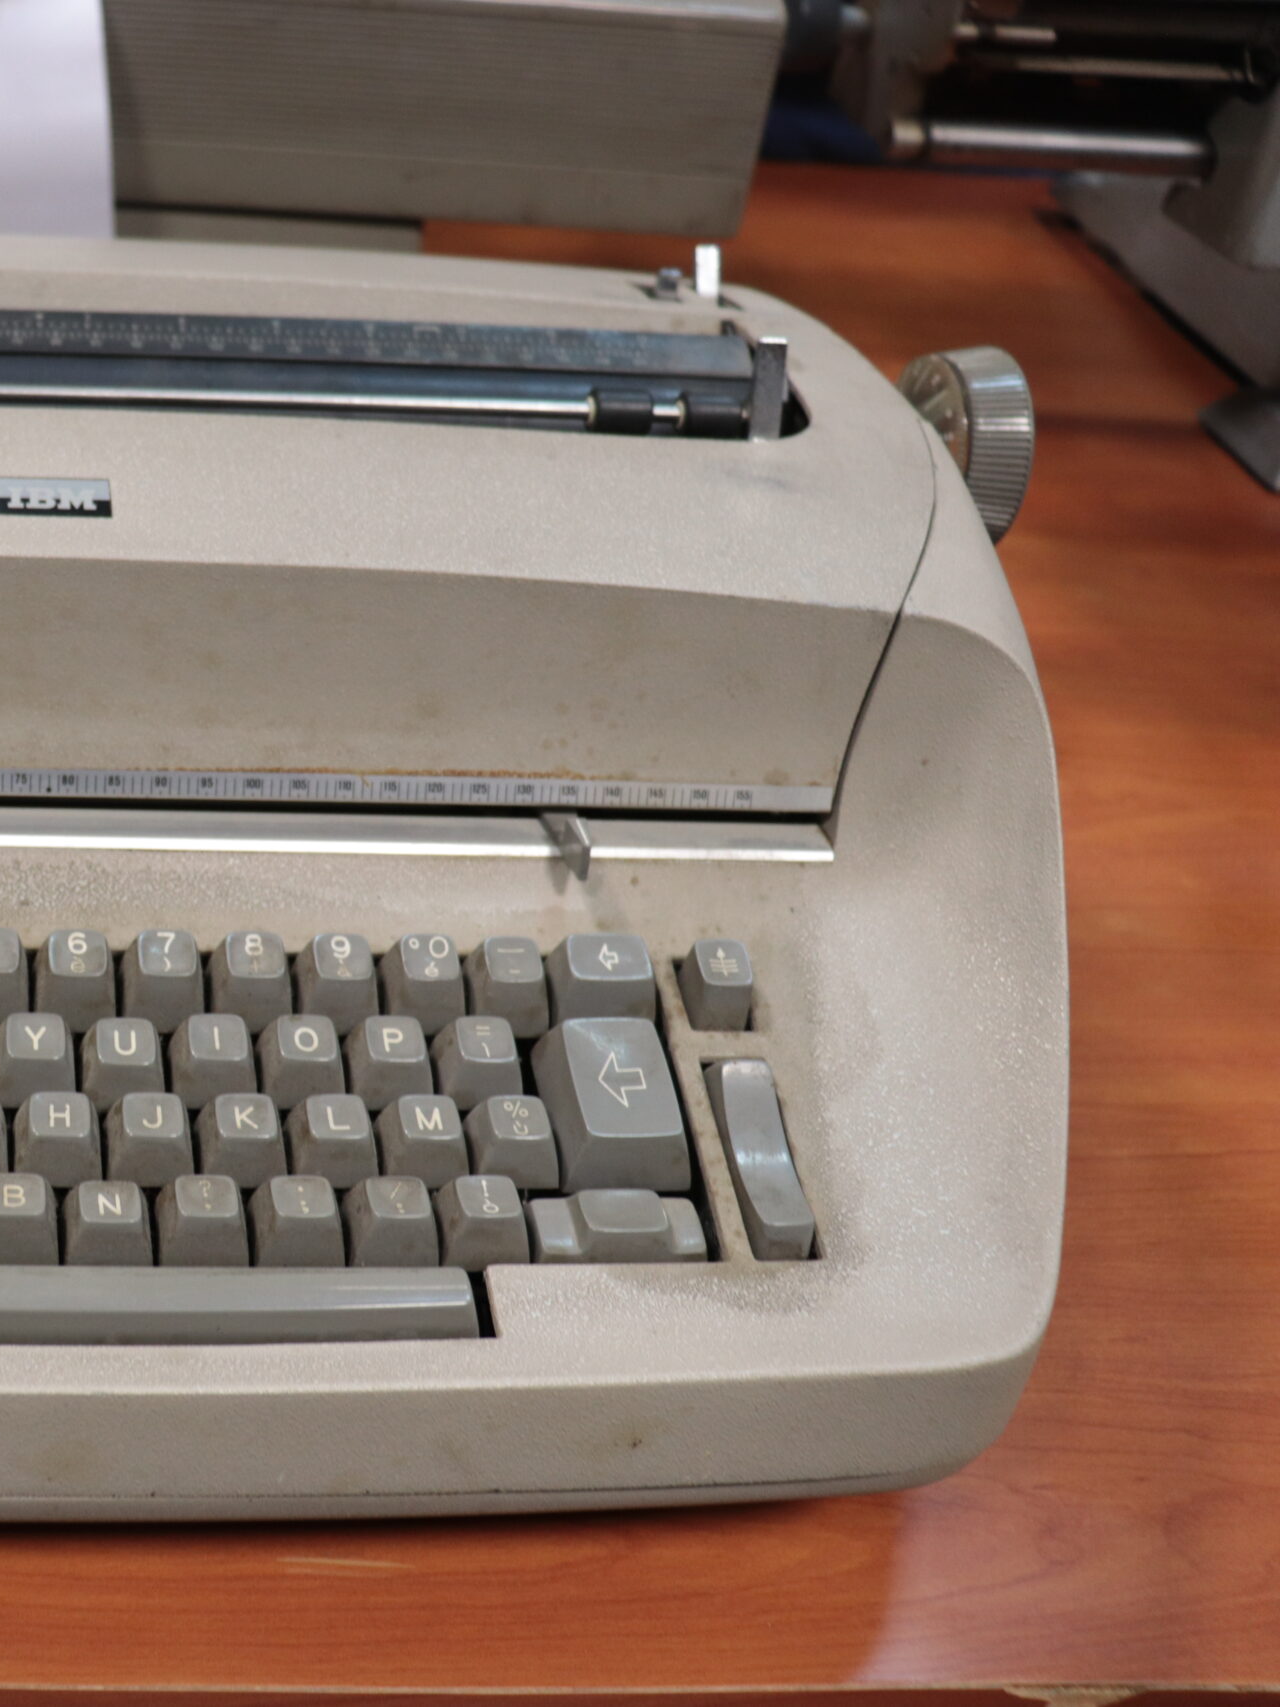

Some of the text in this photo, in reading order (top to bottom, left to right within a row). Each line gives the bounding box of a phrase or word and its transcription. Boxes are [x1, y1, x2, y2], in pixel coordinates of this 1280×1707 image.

[8, 487, 97, 511] IBM
[15, 774, 27, 785] 75
[62, 775, 75, 786] 80
[108, 776, 121, 787] 85
[155, 777, 167, 787] 90
[201, 778, 213, 788] 95
[246, 778, 261, 789] 100
[292, 779, 307, 790] 105
[338, 781, 352, 791] 110
[384, 782, 397, 792] 115
[428, 782, 443, 793] 120
[473, 783, 488, 794] 125
[518, 785, 533, 796] 130
[562, 786, 577, 796] 135
[606, 787, 621, 797] 140
[650, 788, 664, 798] 145
[694, 789, 708, 799] 150
[737, 790, 751, 801] 155
[68, 933, 87, 954] 6
[158, 932, 175, 953] 7
[245, 934, 262, 955] 8
[332, 936, 350, 958] 9
[25, 1026, 46, 1050] Y
[114, 1030, 136, 1055] U
[213, 1026, 221, 1051] I
[295, 1027, 318, 1051] O
[383, 1028, 403, 1052] P
[50, 1104, 70, 1127] H
[143, 1106, 162, 1128] J
[235, 1107, 257, 1128] K
[327, 1106, 350, 1130] L
[416, 1107, 442, 1130] M
[504, 1102, 528, 1117] %
[4, 1185, 25, 1206] B
[98, 1194, 121, 1214] N
